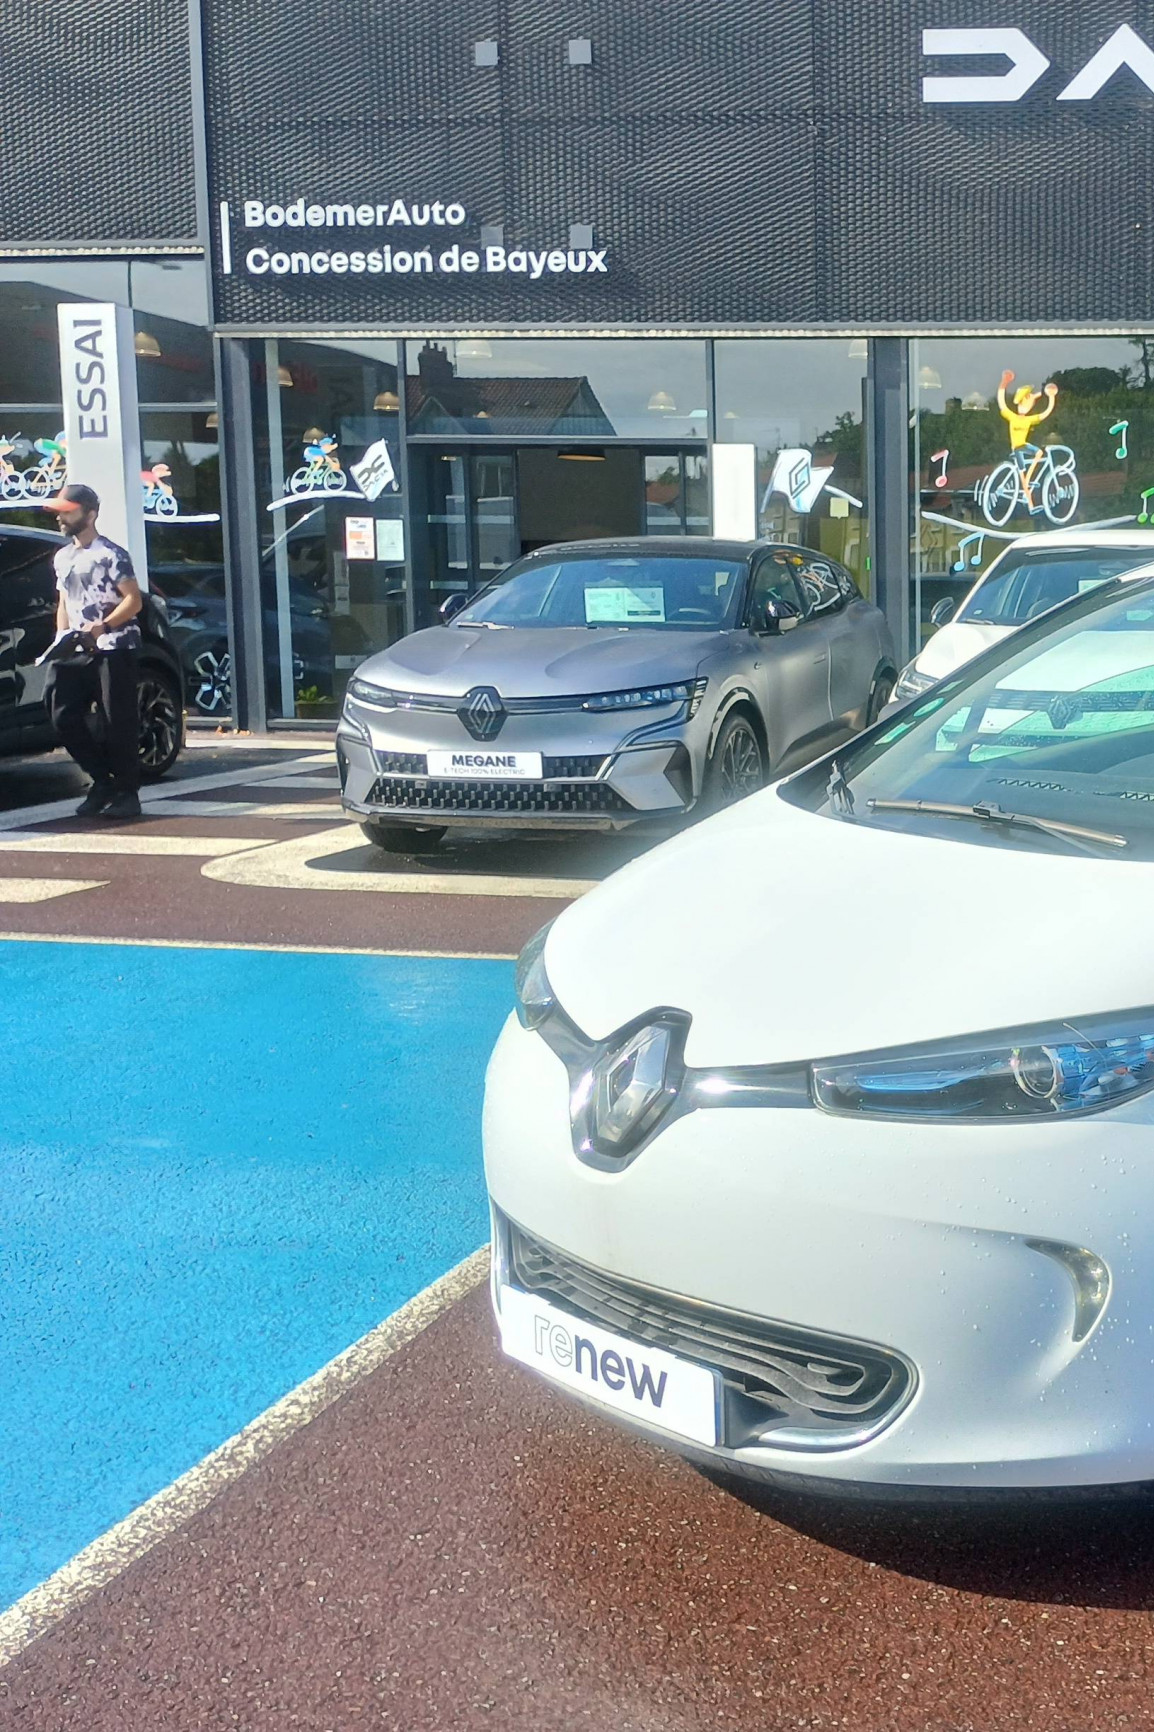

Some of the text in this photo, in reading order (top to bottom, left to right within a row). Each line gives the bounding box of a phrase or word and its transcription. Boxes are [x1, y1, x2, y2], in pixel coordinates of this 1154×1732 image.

[244, 199, 466, 227] BodemerAuto
[246, 245, 608, 279] Concession de Bayeux
[72, 318, 109, 441] ESSAI
[452, 754, 516, 767] MEGANE
[534, 1315, 668, 1408] renew
